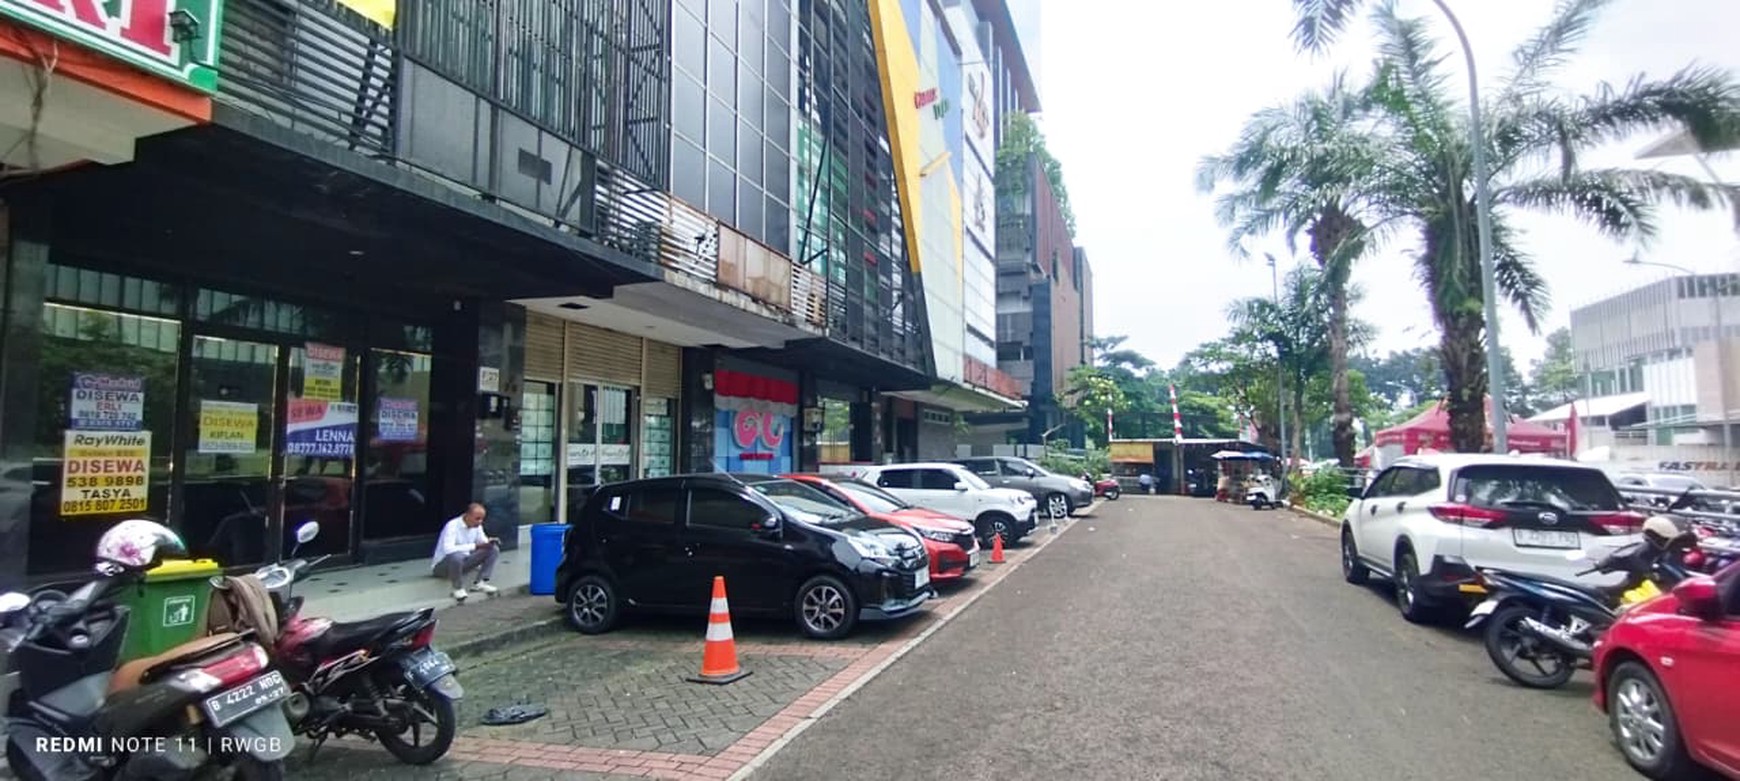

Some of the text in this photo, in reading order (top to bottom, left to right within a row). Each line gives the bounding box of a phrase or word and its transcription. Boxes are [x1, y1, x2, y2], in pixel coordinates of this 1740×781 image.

[76, 389, 140, 402] DISEWA
[291, 405, 322, 418] SEWA
[315, 430, 354, 442] LENNA
[67, 460, 145, 474] DISEWA
[67, 476, 144, 488] 538 9898
[81, 489, 131, 499] TASYA
[211, 700, 221, 711] B
[226, 685, 256, 704] 4222
